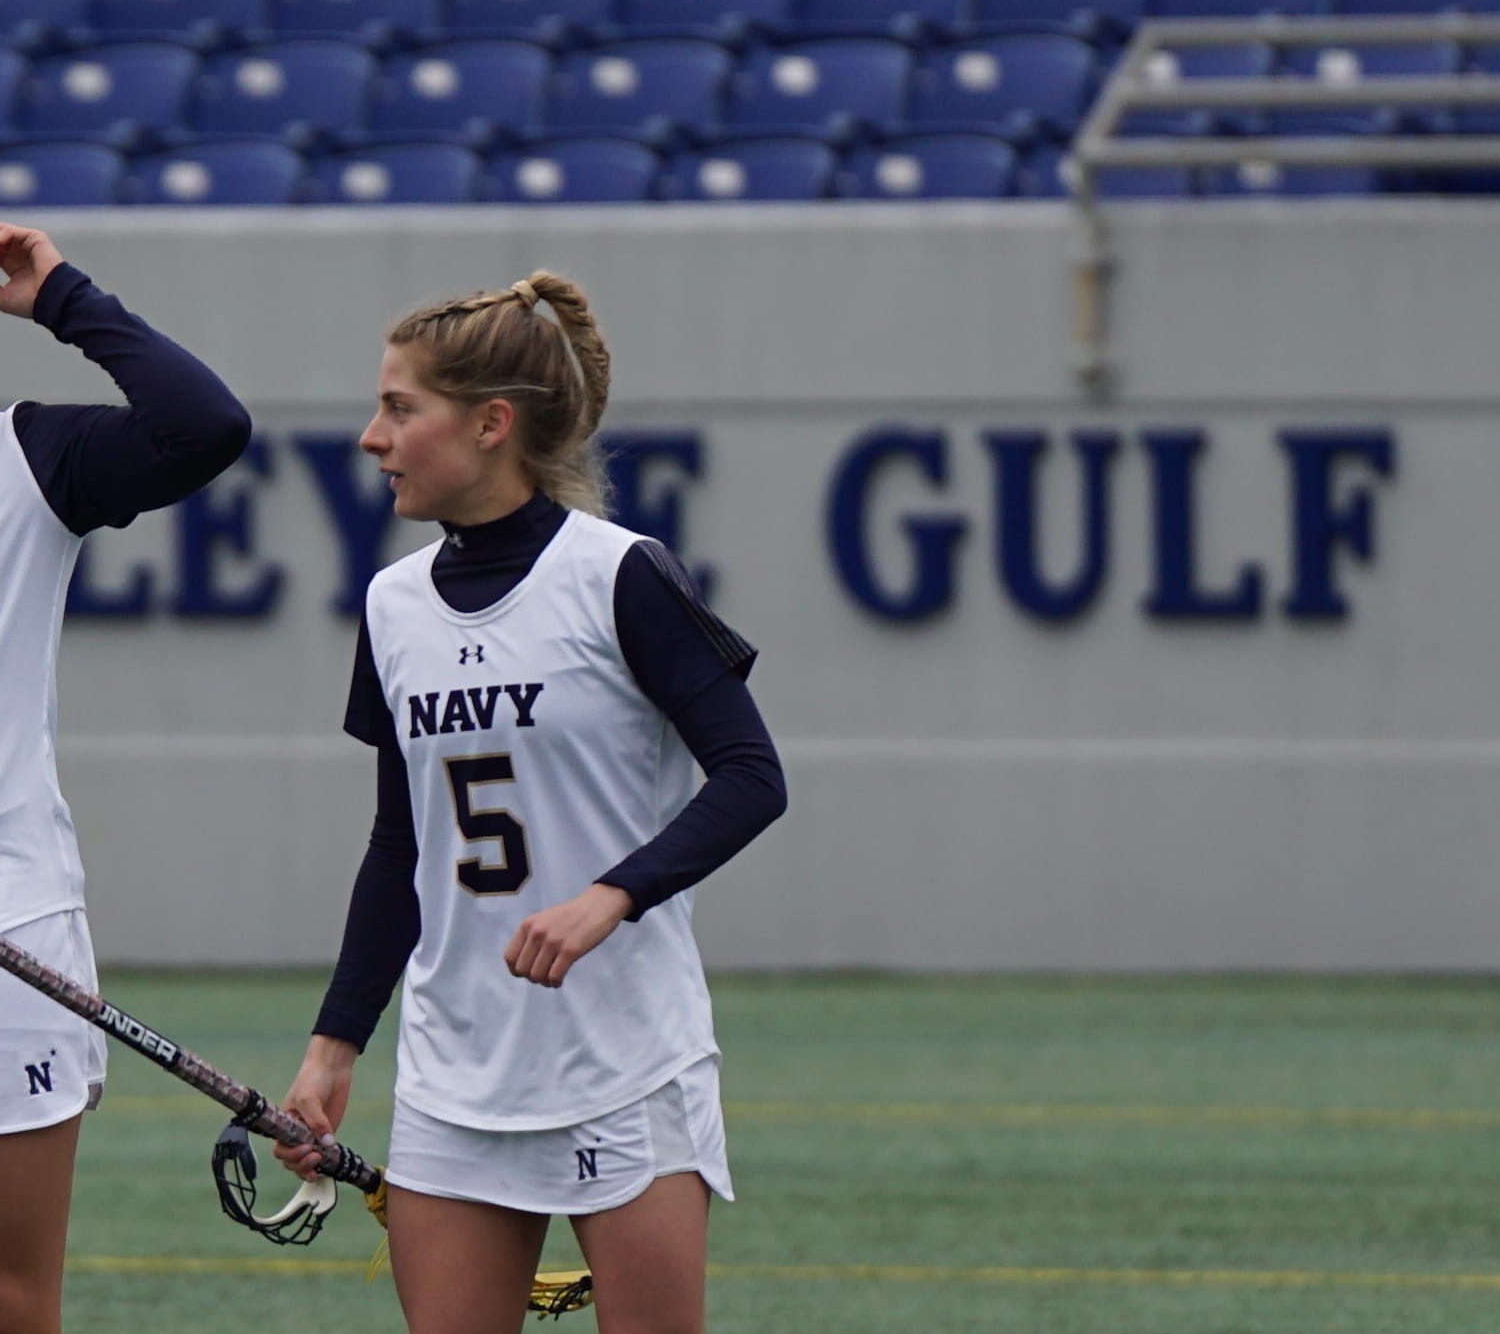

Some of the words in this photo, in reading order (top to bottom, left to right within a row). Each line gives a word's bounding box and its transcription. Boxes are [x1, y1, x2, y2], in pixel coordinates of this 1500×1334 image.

[828, 424, 1396, 621] GULF
[408, 682, 544, 738] NAVY
[443, 752, 531, 896] 5
